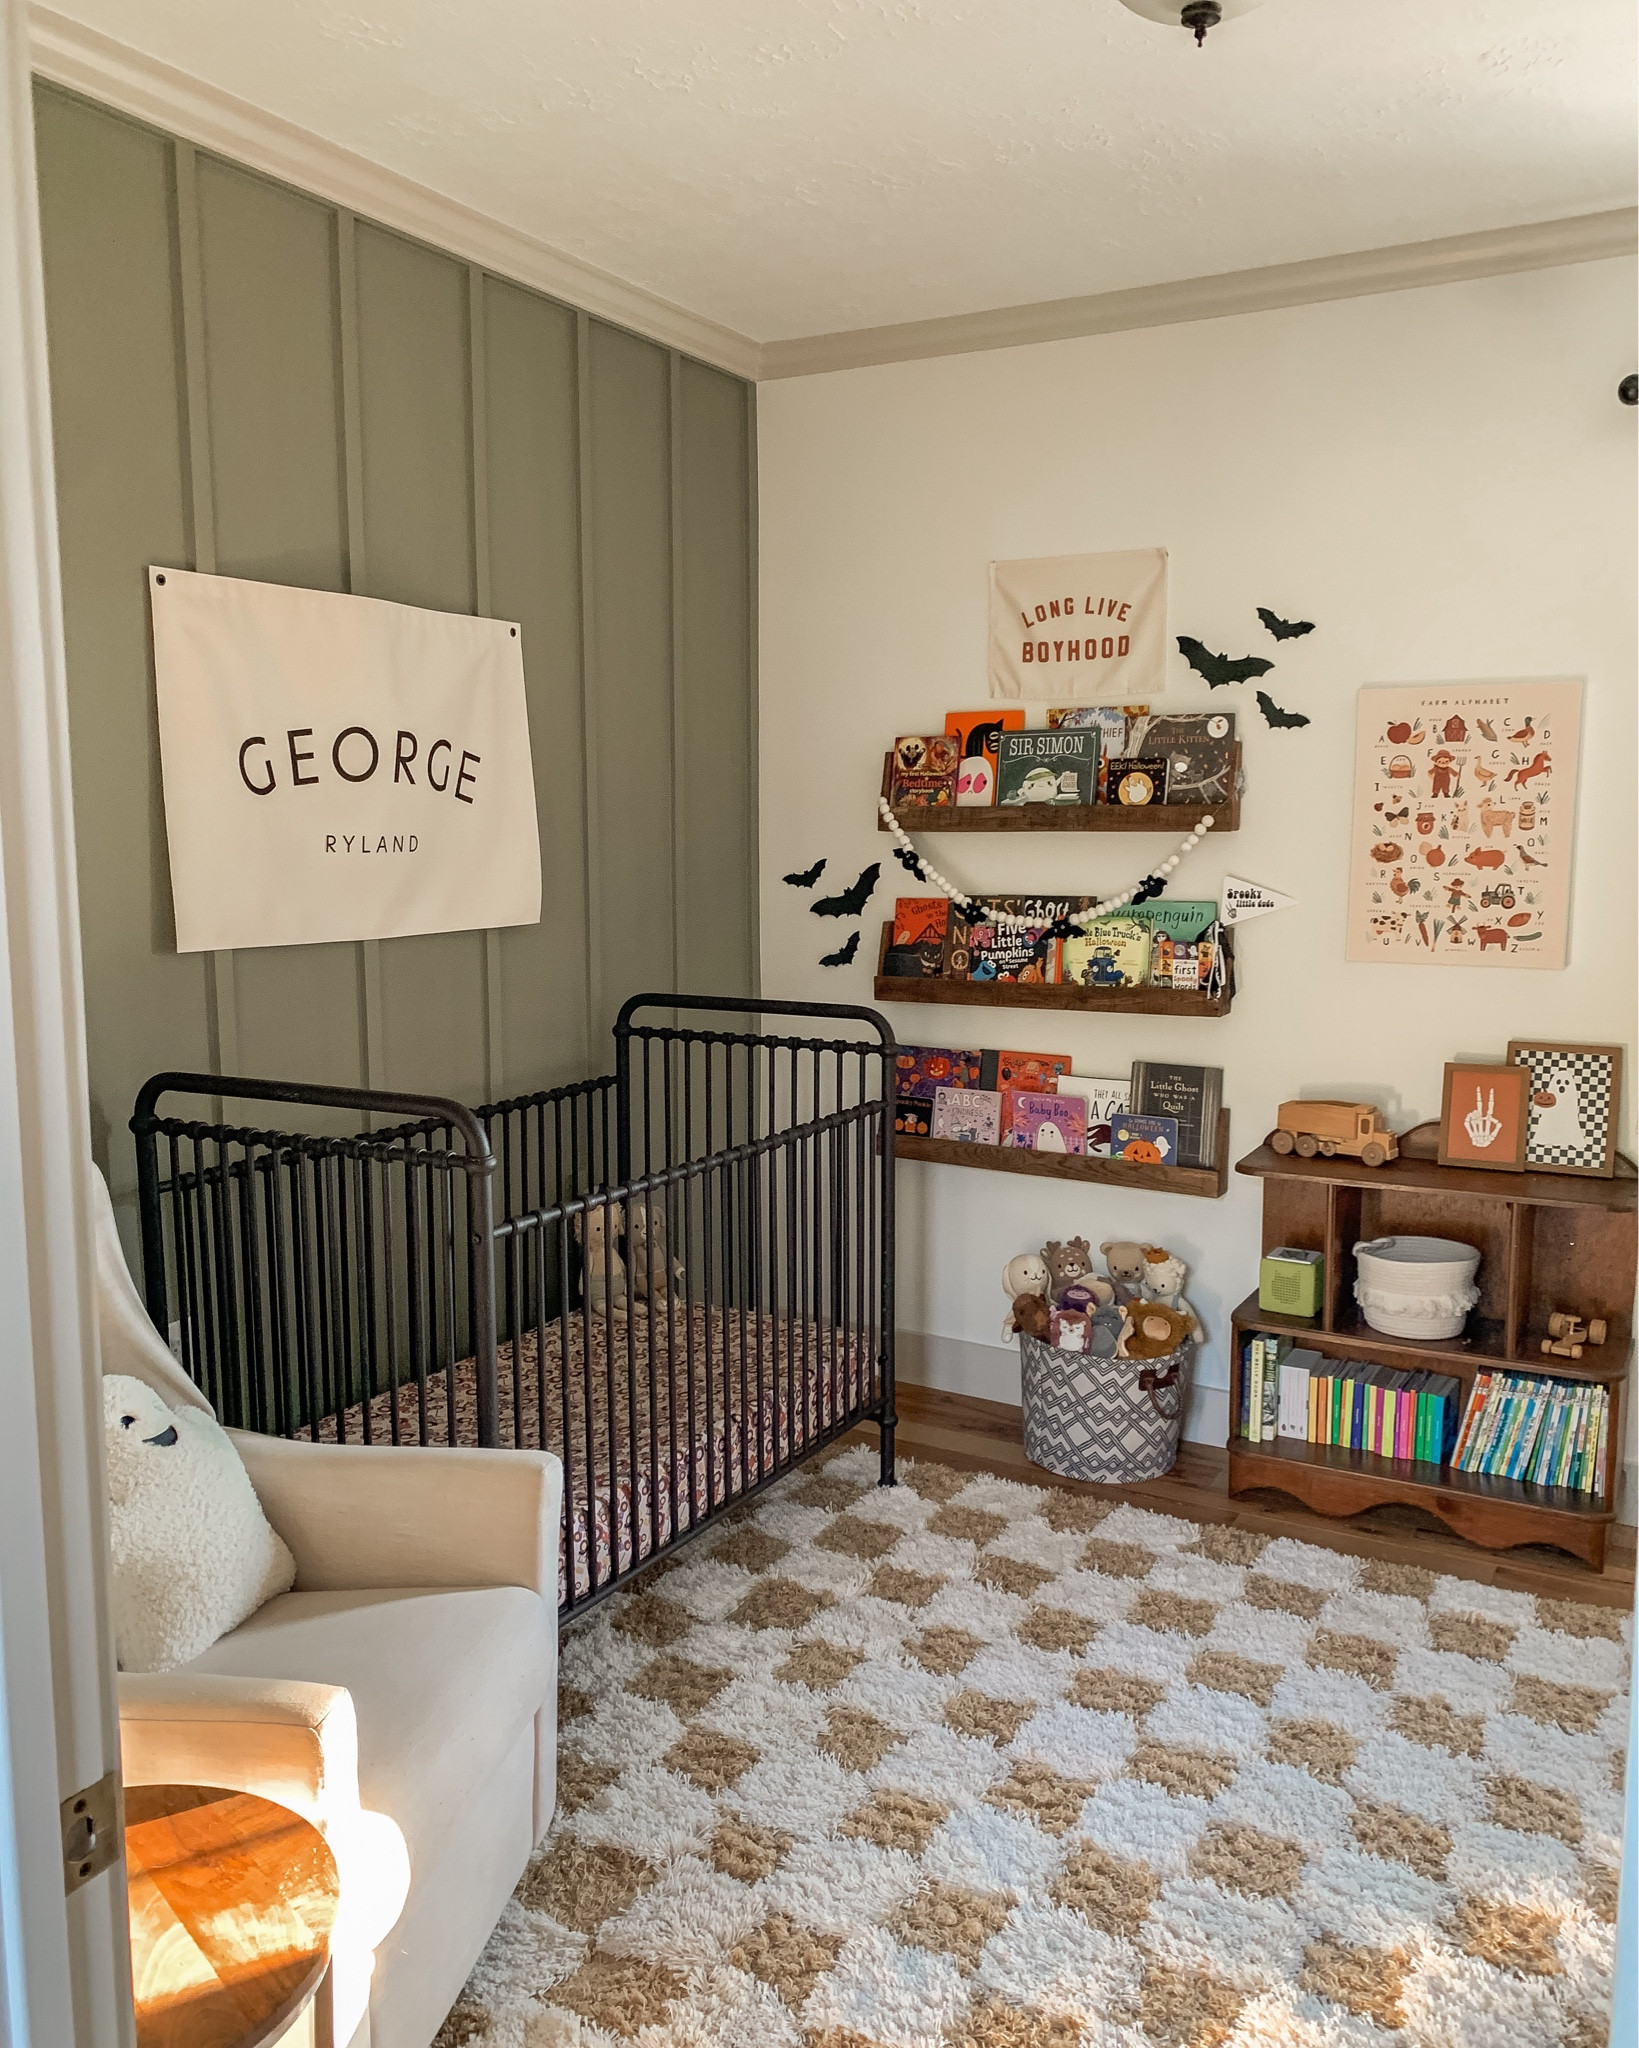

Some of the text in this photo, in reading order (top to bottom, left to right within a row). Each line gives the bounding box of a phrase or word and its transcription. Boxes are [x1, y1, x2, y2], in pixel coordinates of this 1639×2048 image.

[1021, 596, 1132, 628] LONG LIVE
[1022, 635, 1130, 662] BOYHOOD
[1503, 717, 1511, 726] C
[1101, 727, 1123, 738] HIEF
[1543, 730, 1551, 739] D
[1009, 736, 1084, 756] SIR SIMON
[1427, 748, 1433, 757] F
[1491, 749, 1500, 759] G
[239, 726, 481, 804] GEORGE
[1380, 756, 1386, 765] E
[1522, 757, 1529, 765] H
[902, 779, 943, 788] Bedtime
[1374, 782, 1380, 792] I
[1500, 795, 1506, 804] L
[1416, 802, 1422, 810] J
[1441, 813, 1447, 822] K
[1539, 817, 1547, 826] M
[1404, 832, 1412, 841] N
[326, 835, 419, 853] RYLAND
[1465, 843, 1471, 852] P
[1410, 854, 1418, 863] O
[1380, 869, 1386, 879] R
[1433, 872, 1440, 881] S
[1517, 887, 1524, 895] T
[911, 900, 943, 915] Ghosts
[1236, 900, 1274, 908] little dude
[1537, 911, 1544, 919] Y
[1495, 916, 1502, 925] X
[997, 922, 1027, 936] Five
[1094, 927, 1111, 937] Blue
[1112, 927, 1142, 941] Truck's
[991, 934, 1023, 949] Little
[1085, 937, 1126, 947] Halloween
[1383, 937, 1389, 945] U
[1510, 944, 1518, 953] Z
[981, 947, 1035, 962] Pumpkins
[1174, 964, 1197, 975] first
[1150, 1081, 1199, 1093] Little Ghost
[1094, 1089, 1108, 1099] THEY
[1112, 1090, 1121, 1100] ALL
[1029, 1101, 1068, 1120] Baby Boo
[1091, 1101, 1099, 1120] A
[1162, 1101, 1184, 1114] Quilt
[951, 1108, 983, 1117] KINDNESS
